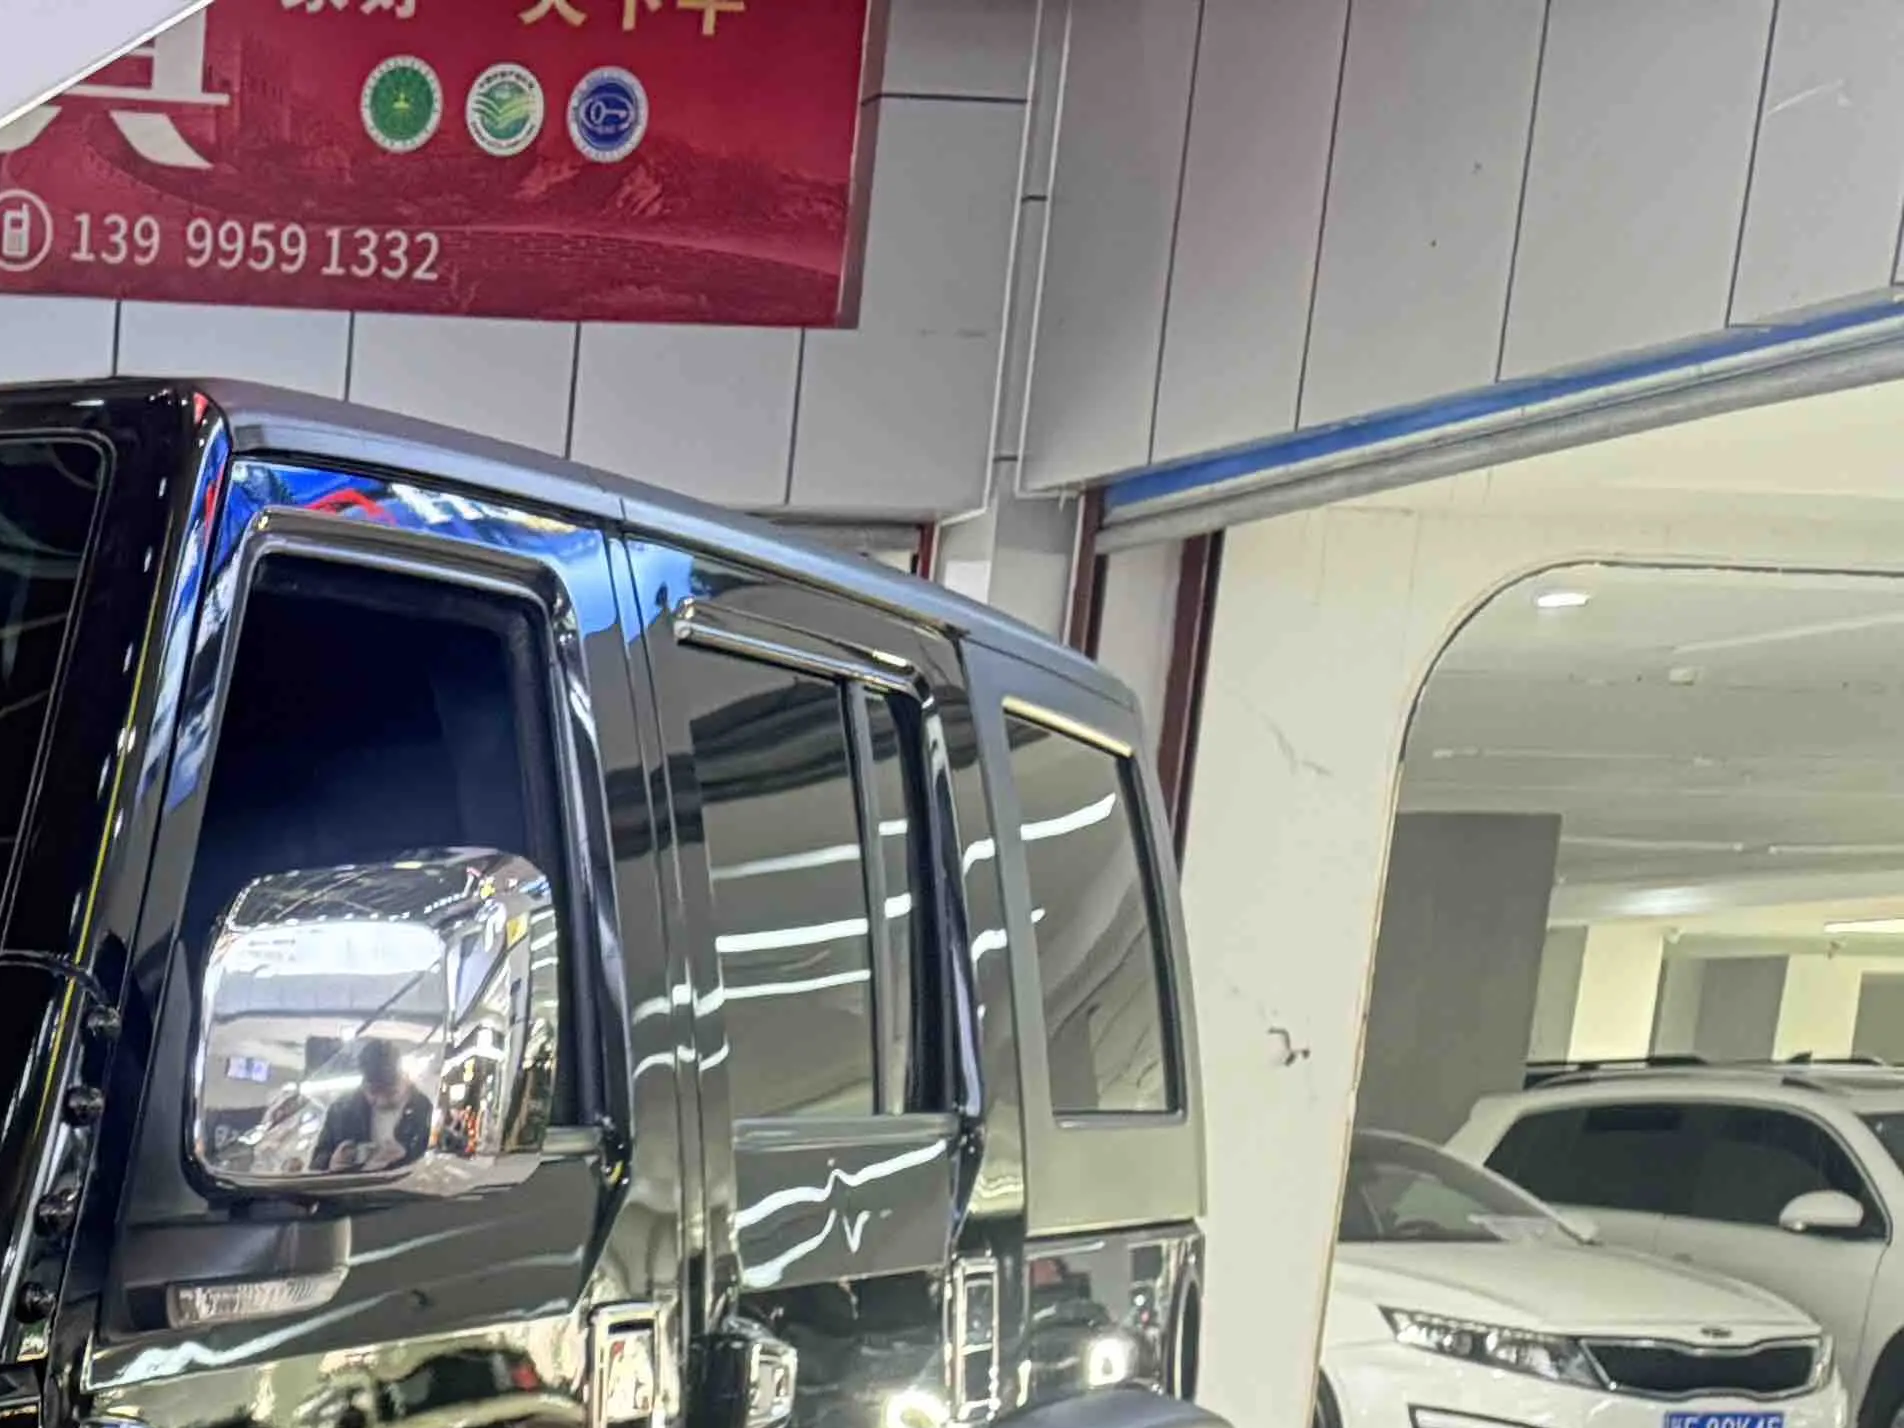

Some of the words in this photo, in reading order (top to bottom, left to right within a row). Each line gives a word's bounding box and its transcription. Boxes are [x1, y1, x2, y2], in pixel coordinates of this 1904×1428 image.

[71, 213, 161, 266] 139
[186, 217, 308, 274] 9959
[321, 228, 441, 282] 1332
